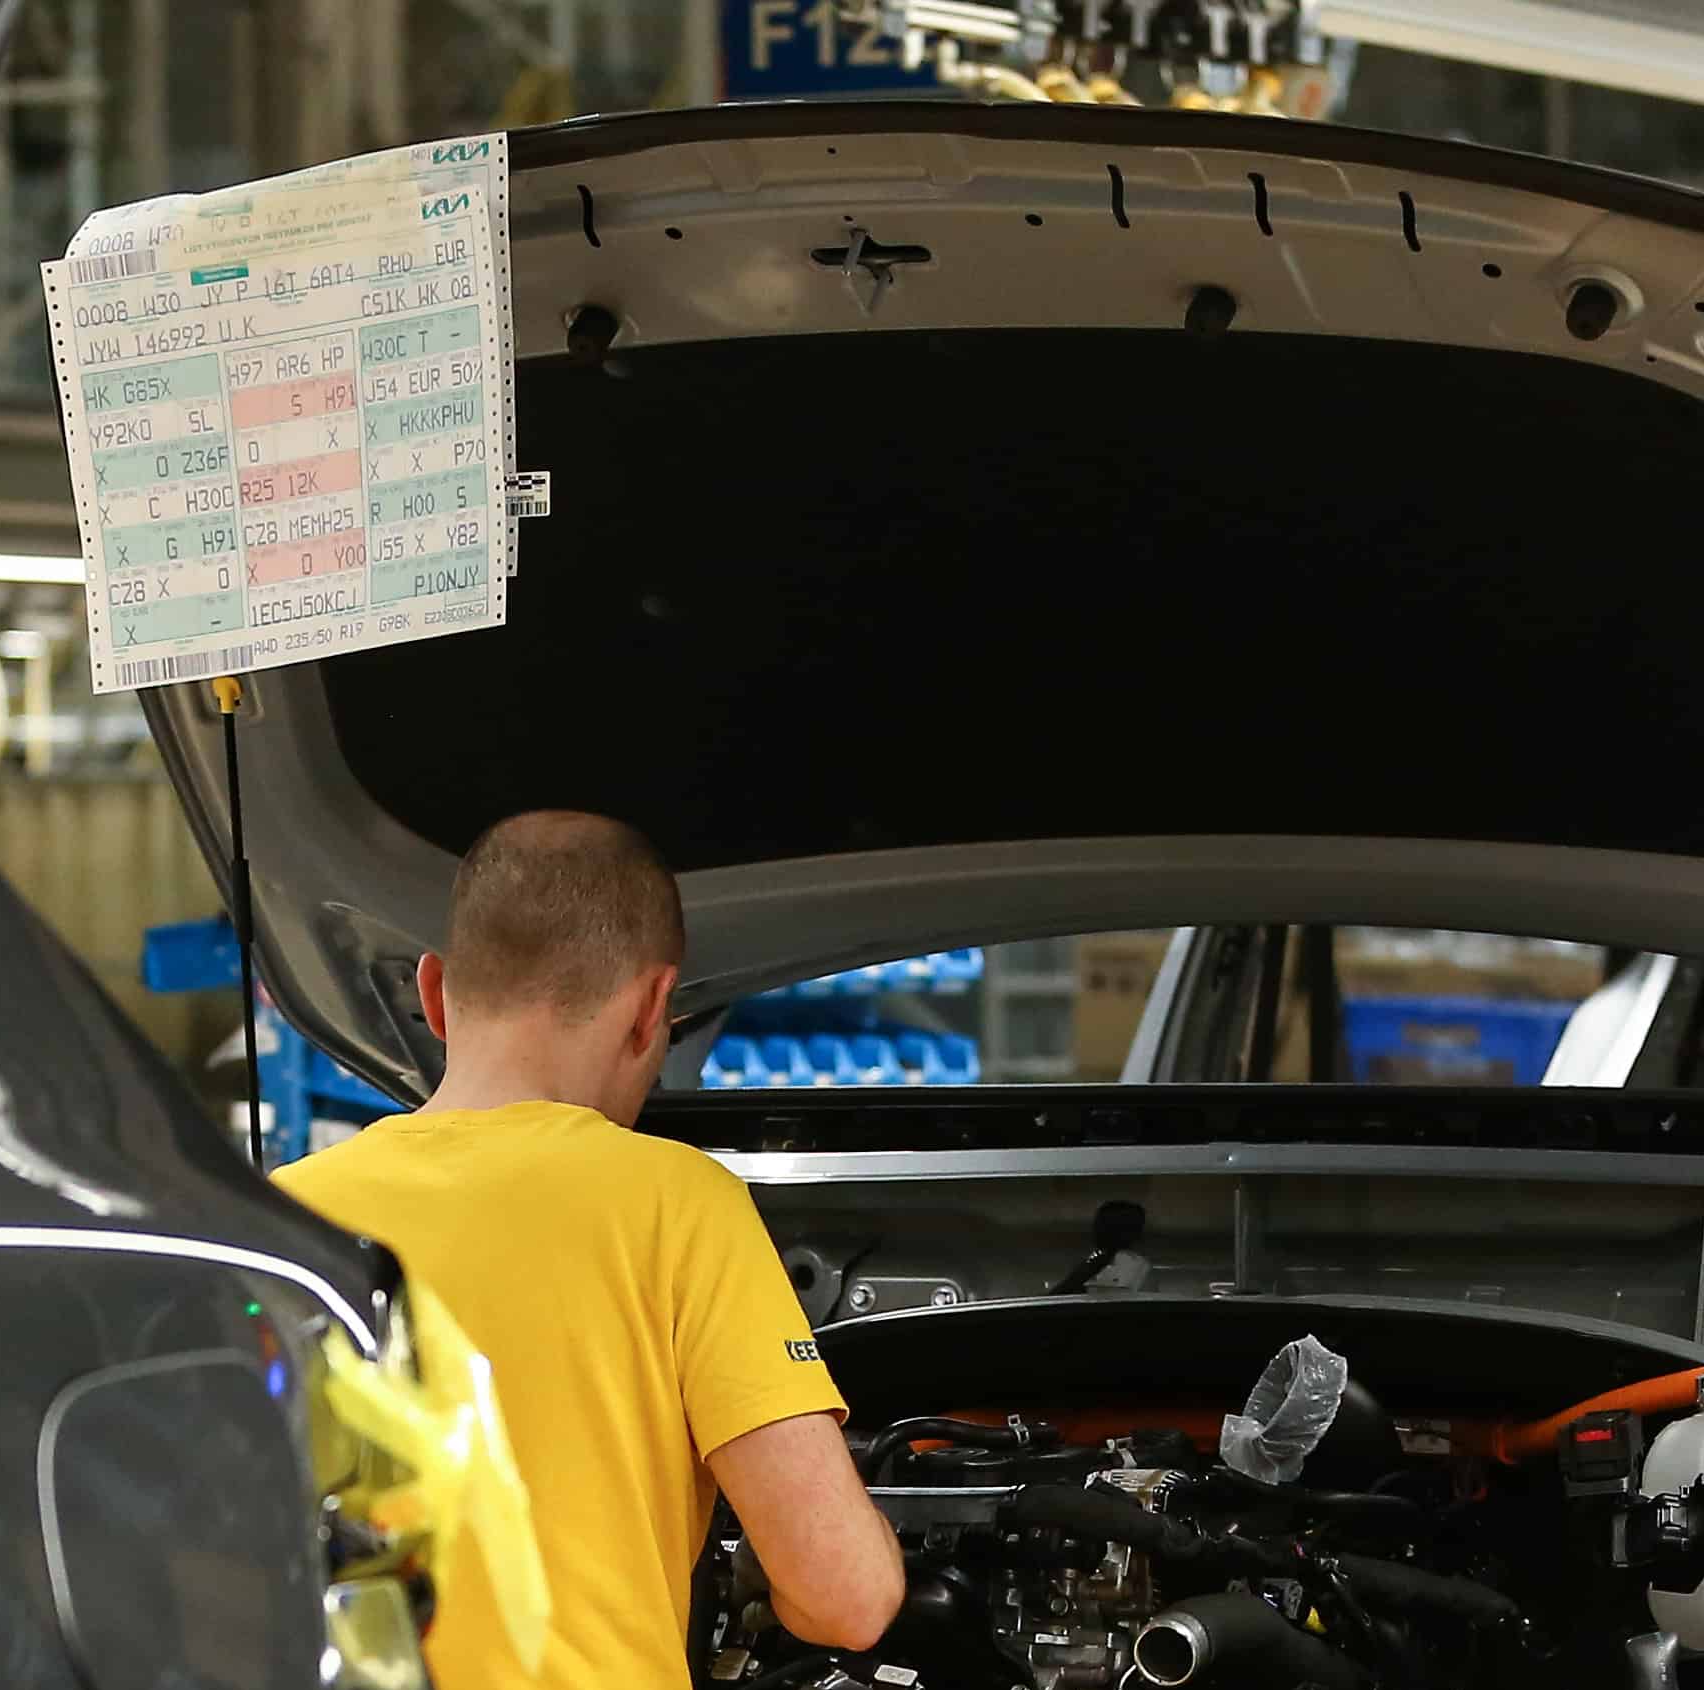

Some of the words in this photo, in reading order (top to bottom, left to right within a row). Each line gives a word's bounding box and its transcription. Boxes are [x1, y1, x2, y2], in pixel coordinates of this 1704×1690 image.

[76, 300, 129, 328] 0008
[143, 292, 181, 316] W30
[201, 284, 223, 308] JY
[236, 279, 249, 301] P
[434, 239, 466, 266] EUR
[83, 337, 121, 365] JYW
[135, 323, 208, 356] 146992
[418, 281, 442, 306] WK
[418, 330, 428, 352] T
[228, 361, 263, 386] H97
[276, 353, 311, 379] AR6
[321, 346, 344, 371] HP
[84, 386, 112, 410] HK
[364, 377, 398, 402] J54
[408, 367, 441, 394] EUR
[328, 426, 339, 449] X
[367, 420, 378, 441] X
[94, 465, 108, 485] X
[369, 460, 380, 481] X
[411, 451, 423, 472] X
[454, 439, 486, 465] P70
[240, 478, 275, 505] R25
[289, 472, 319, 497] 12K
[99, 504, 113, 526] X
[148, 496, 162, 519] C
[370, 502, 382, 525] R
[117, 545, 130, 566] X
[165, 537, 178, 560] G
[202, 527, 237, 555] H91
[373, 535, 404, 562] J55
[414, 532, 425, 554] X
[157, 577, 170, 599] X
[248, 562, 258, 585] X
[125, 625, 138, 645] X
[254, 638, 278, 655] AWD
[285, 628, 332, 650] 235/50
[340, 622, 364, 640] R19
